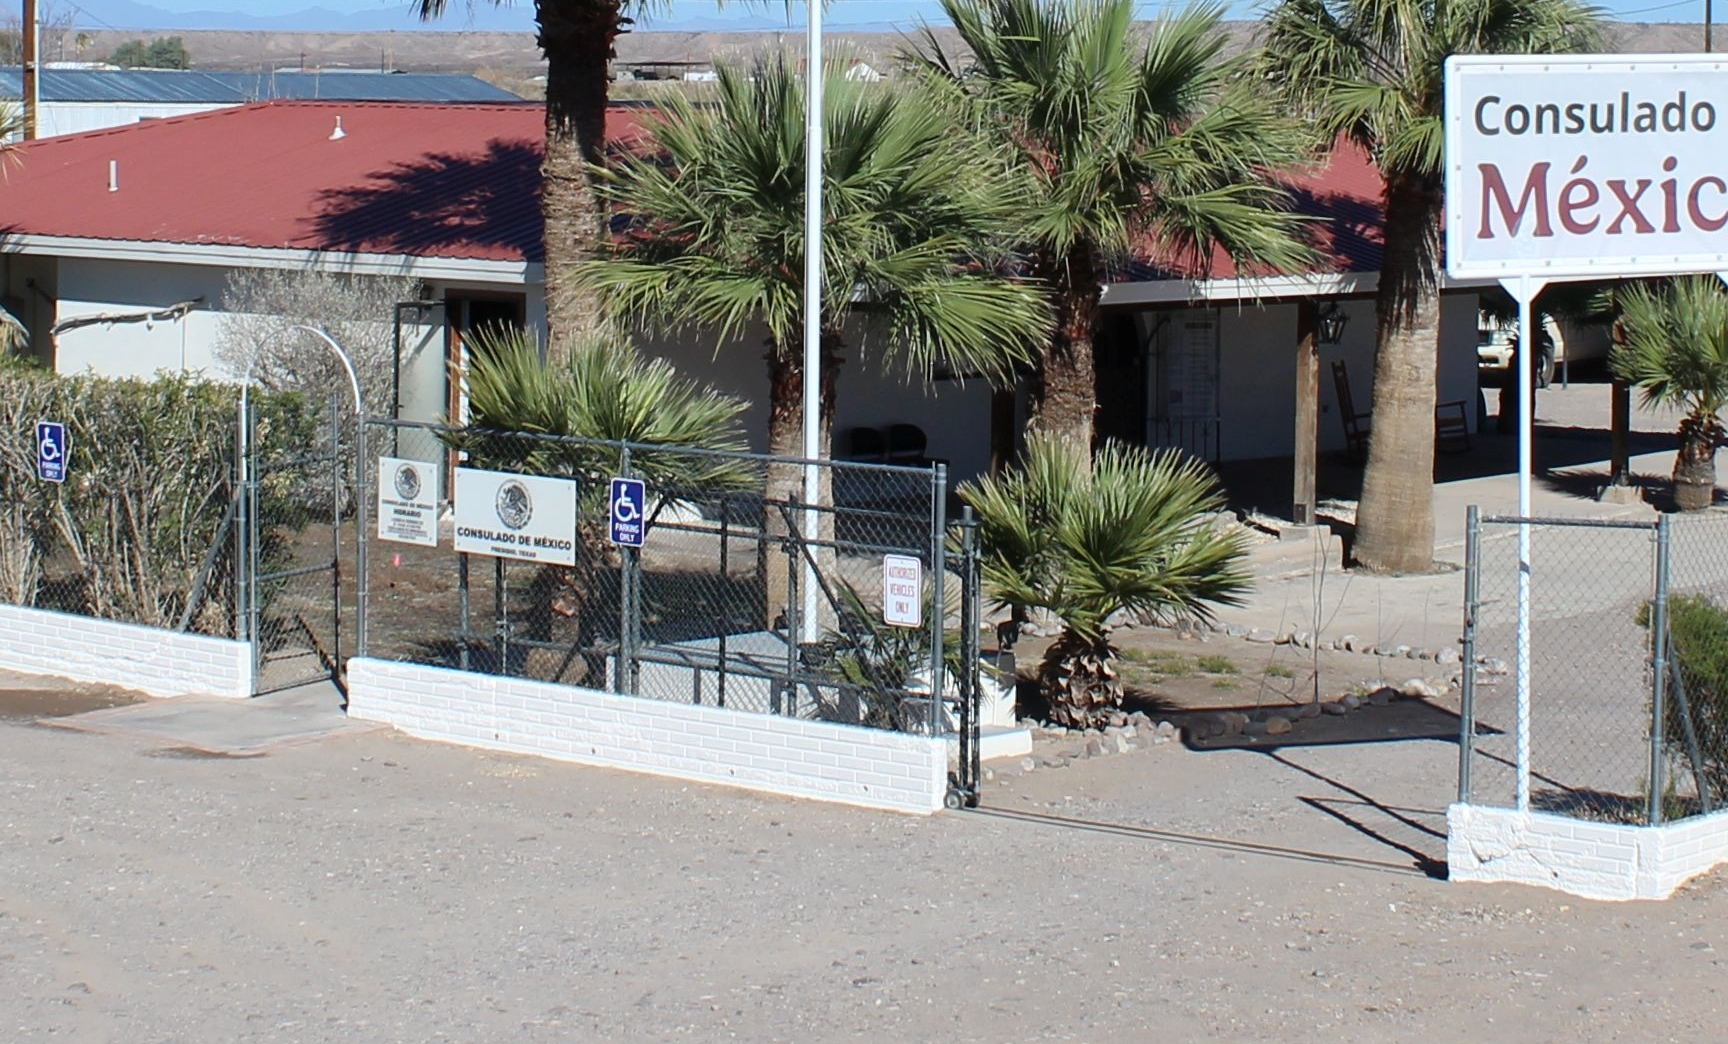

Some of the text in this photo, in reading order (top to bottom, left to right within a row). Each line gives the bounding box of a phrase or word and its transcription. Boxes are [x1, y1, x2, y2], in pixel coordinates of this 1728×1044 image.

[1474, 91, 1716, 136] Consulado
[393, 508, 422, 518] HORARIO
[615, 522, 640, 534] PARKING
[457, 526, 572, 550] CONSULADO DE MÉXICO
[620, 533, 635, 542] ONLY
[519, 550, 536, 558] TEXAS
[889, 566, 916, 580] AUTHORIZED
[890, 583, 915, 597] VEHICLES
[895, 600, 909, 614] ONLY
